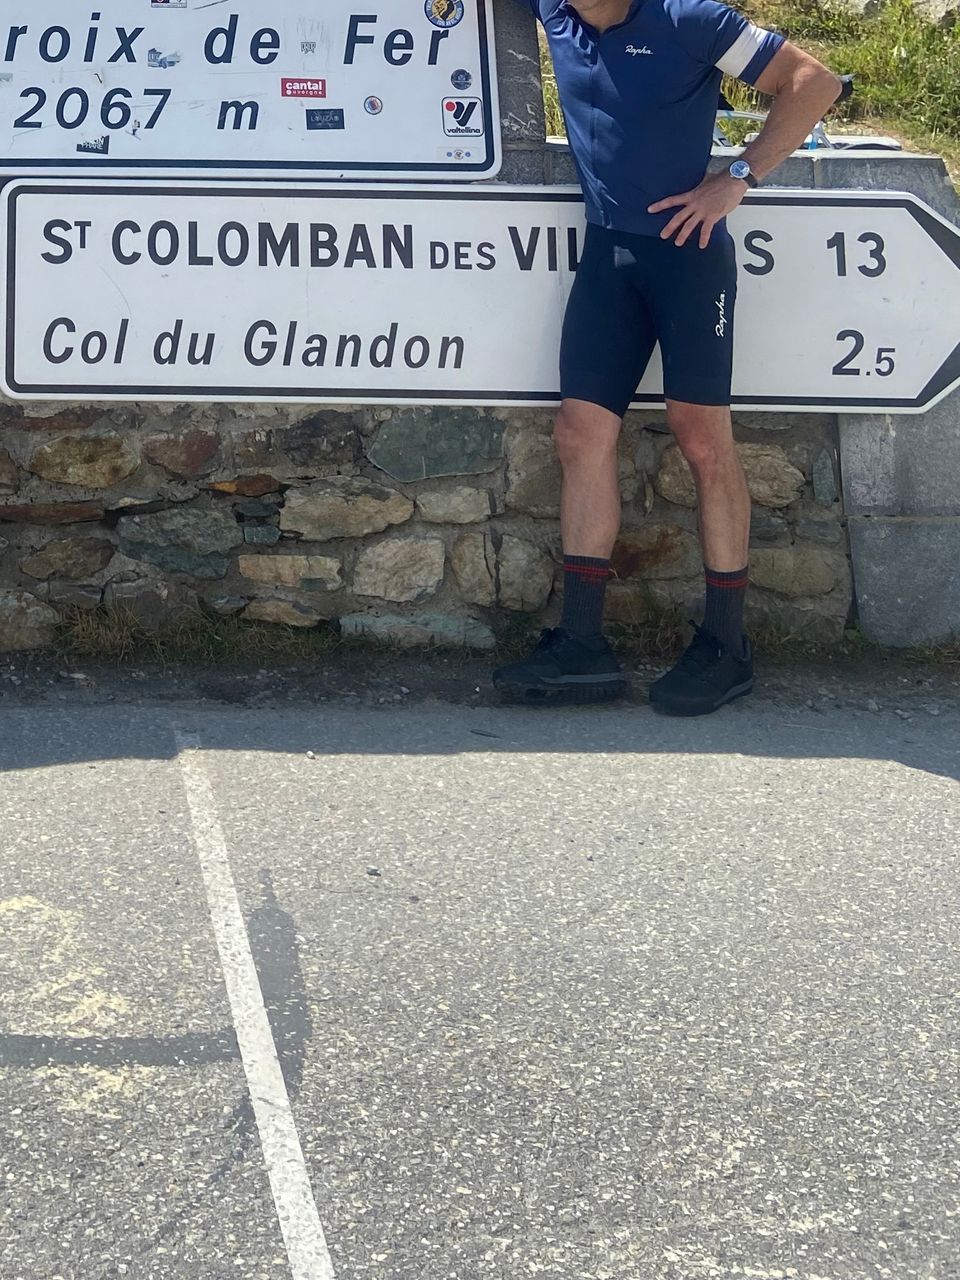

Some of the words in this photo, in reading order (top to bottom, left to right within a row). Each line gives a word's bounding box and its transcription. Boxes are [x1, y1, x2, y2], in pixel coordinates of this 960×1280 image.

[205, 14, 280, 65] de
[344, 14, 449, 66] Fer
[14, 87, 171, 130] 2067
[217, 101, 259, 130] m
[286, 81, 323, 90] cantal
[447, 126, 480, 134] valtellina
[41, 219, 91, 265] ST
[112, 220, 414, 269] COLOMBAN
[430, 242, 496, 271] DES
[827, 232, 887, 278] 13
[43, 317, 129, 364] Col
[154, 319, 215, 366] du
[245, 320, 464, 369] Glandon
[832, 329, 896, 377] 2.5
